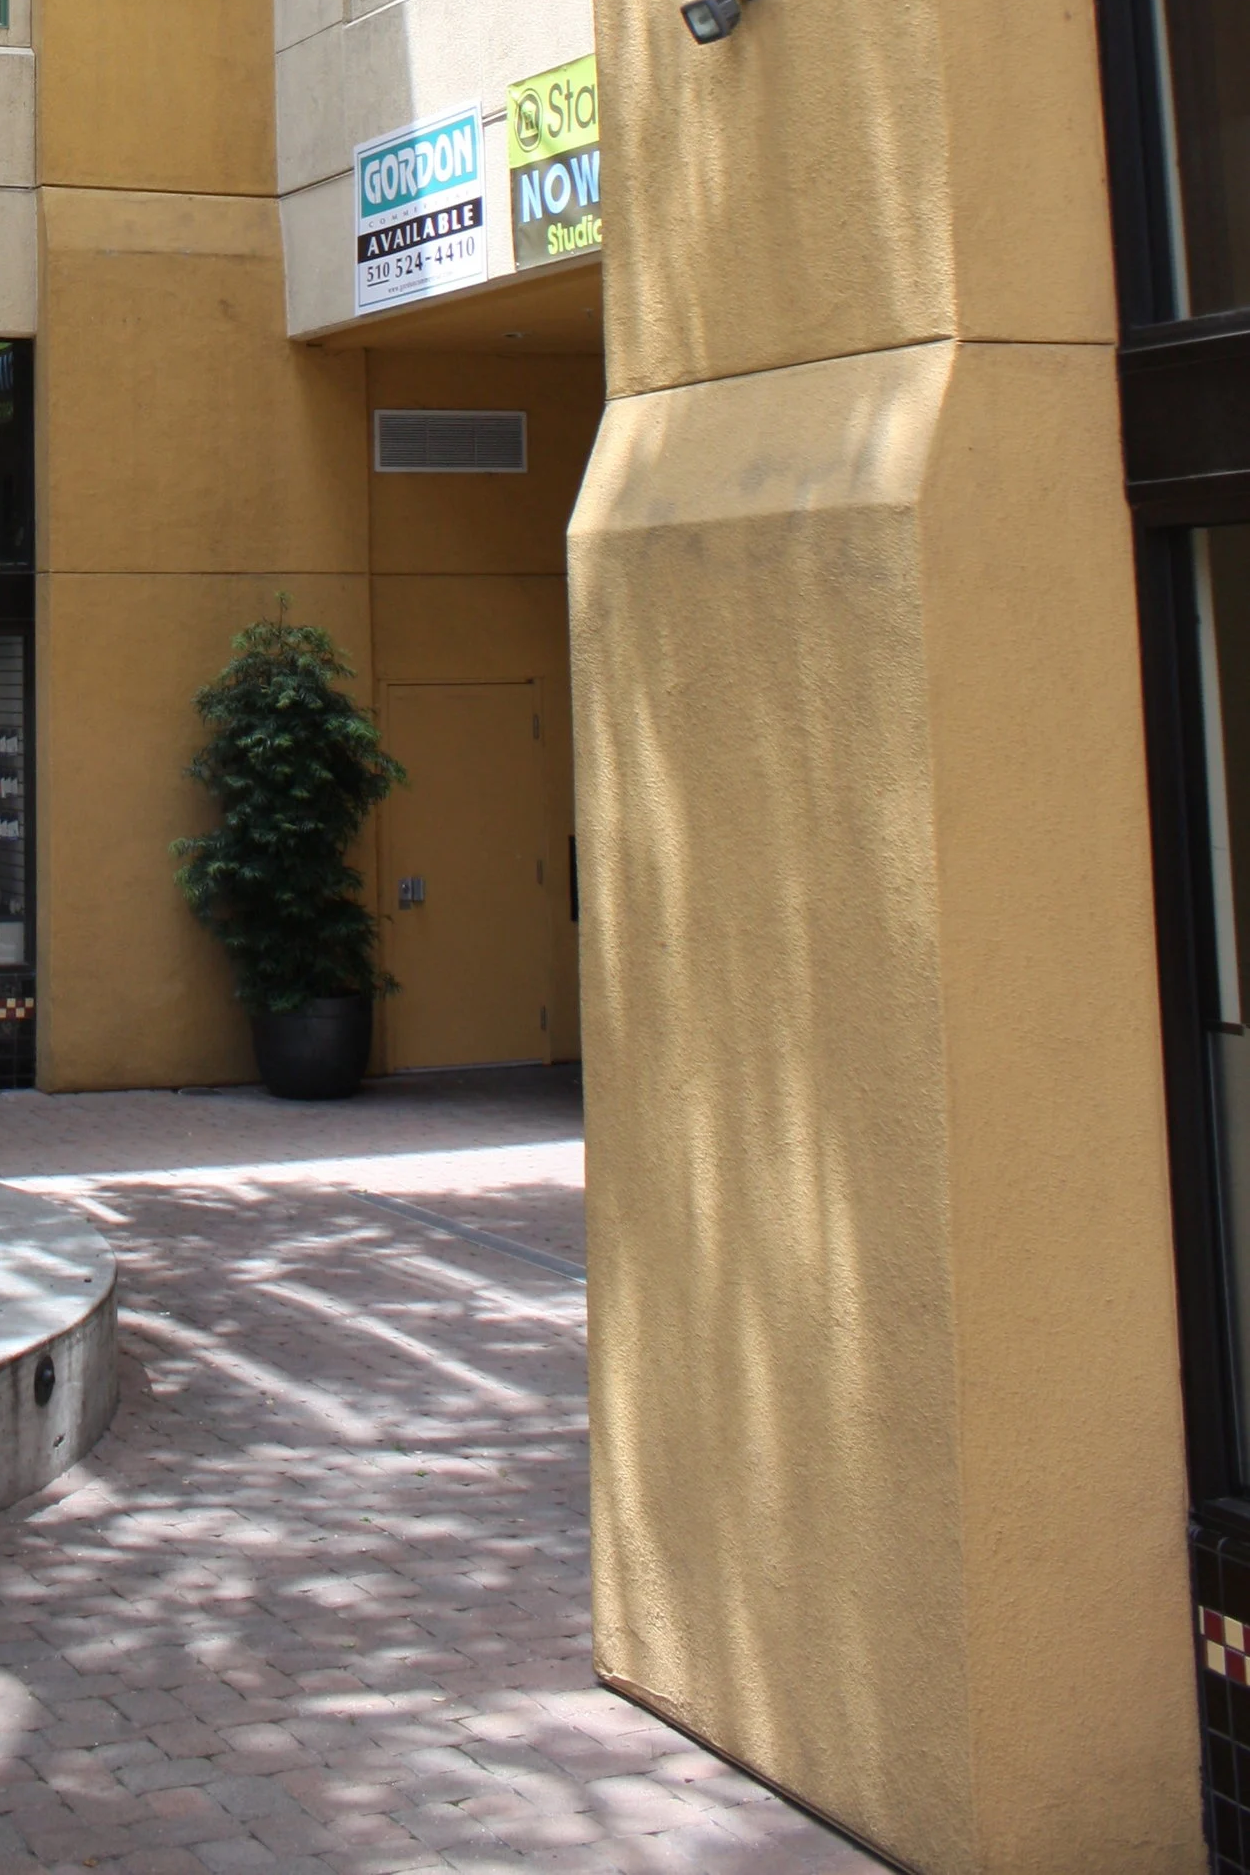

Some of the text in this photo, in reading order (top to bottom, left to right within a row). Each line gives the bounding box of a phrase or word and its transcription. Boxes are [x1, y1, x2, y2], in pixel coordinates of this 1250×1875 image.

[364, 124, 473, 205] GORDON
[520, 150, 600, 224] NOW
[367, 187, 470, 229] COMME
[367, 203, 475, 258] AVAILABLE
[366, 235, 476, 283] 510 524-4410
